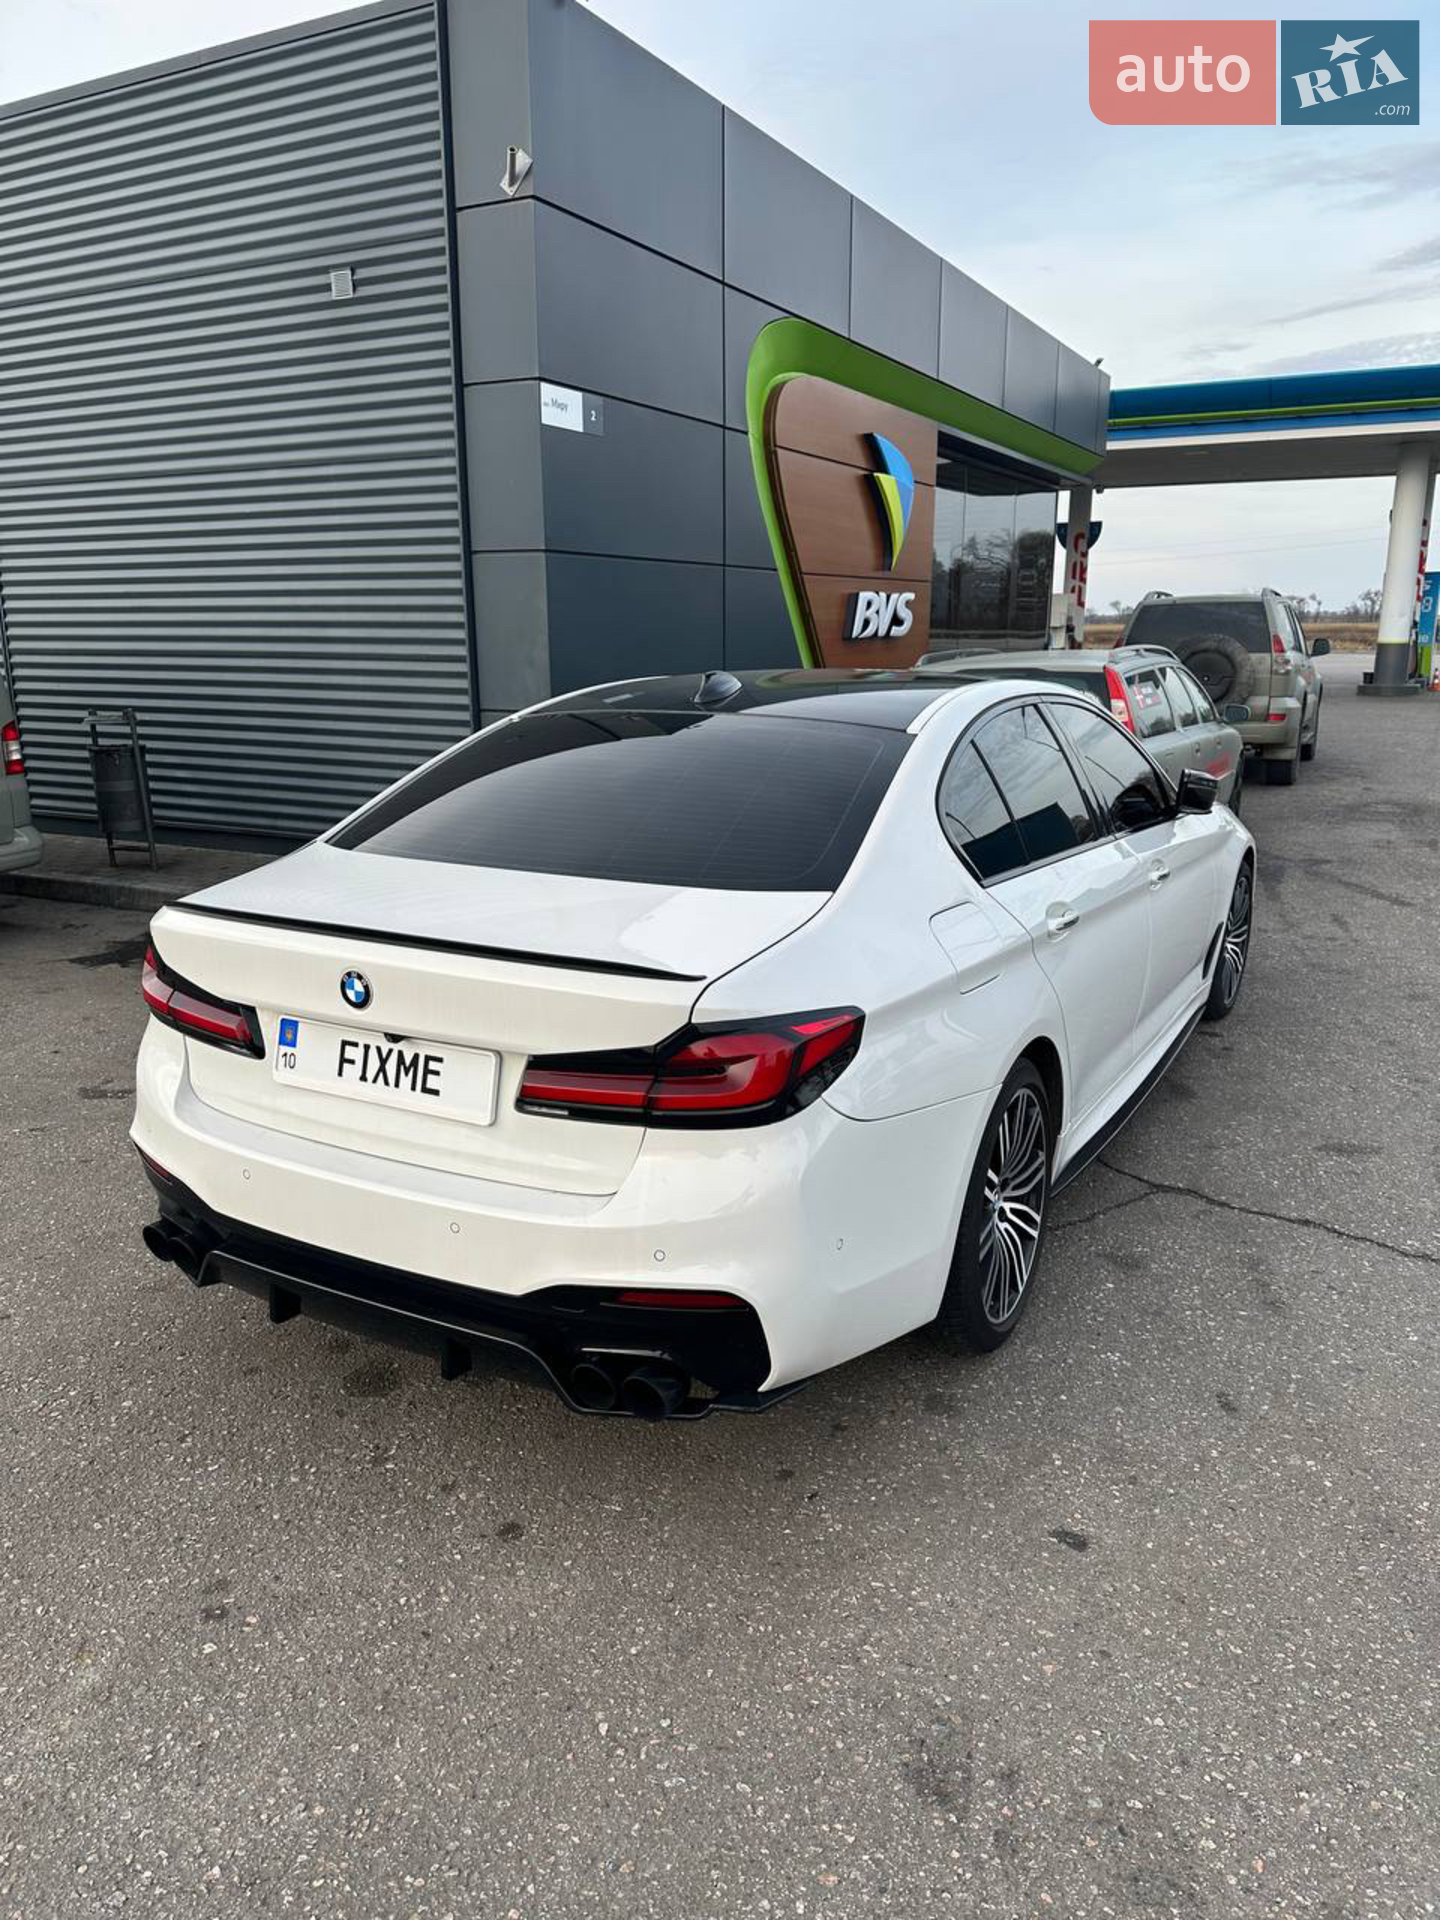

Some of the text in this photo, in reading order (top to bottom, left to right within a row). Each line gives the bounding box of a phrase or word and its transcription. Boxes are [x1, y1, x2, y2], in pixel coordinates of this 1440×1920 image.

[590, 409, 597, 421] 2
[851, 590, 916, 639] BVS
[281, 1051, 297, 1070] 10
[337, 1039, 444, 1097] FIXME
